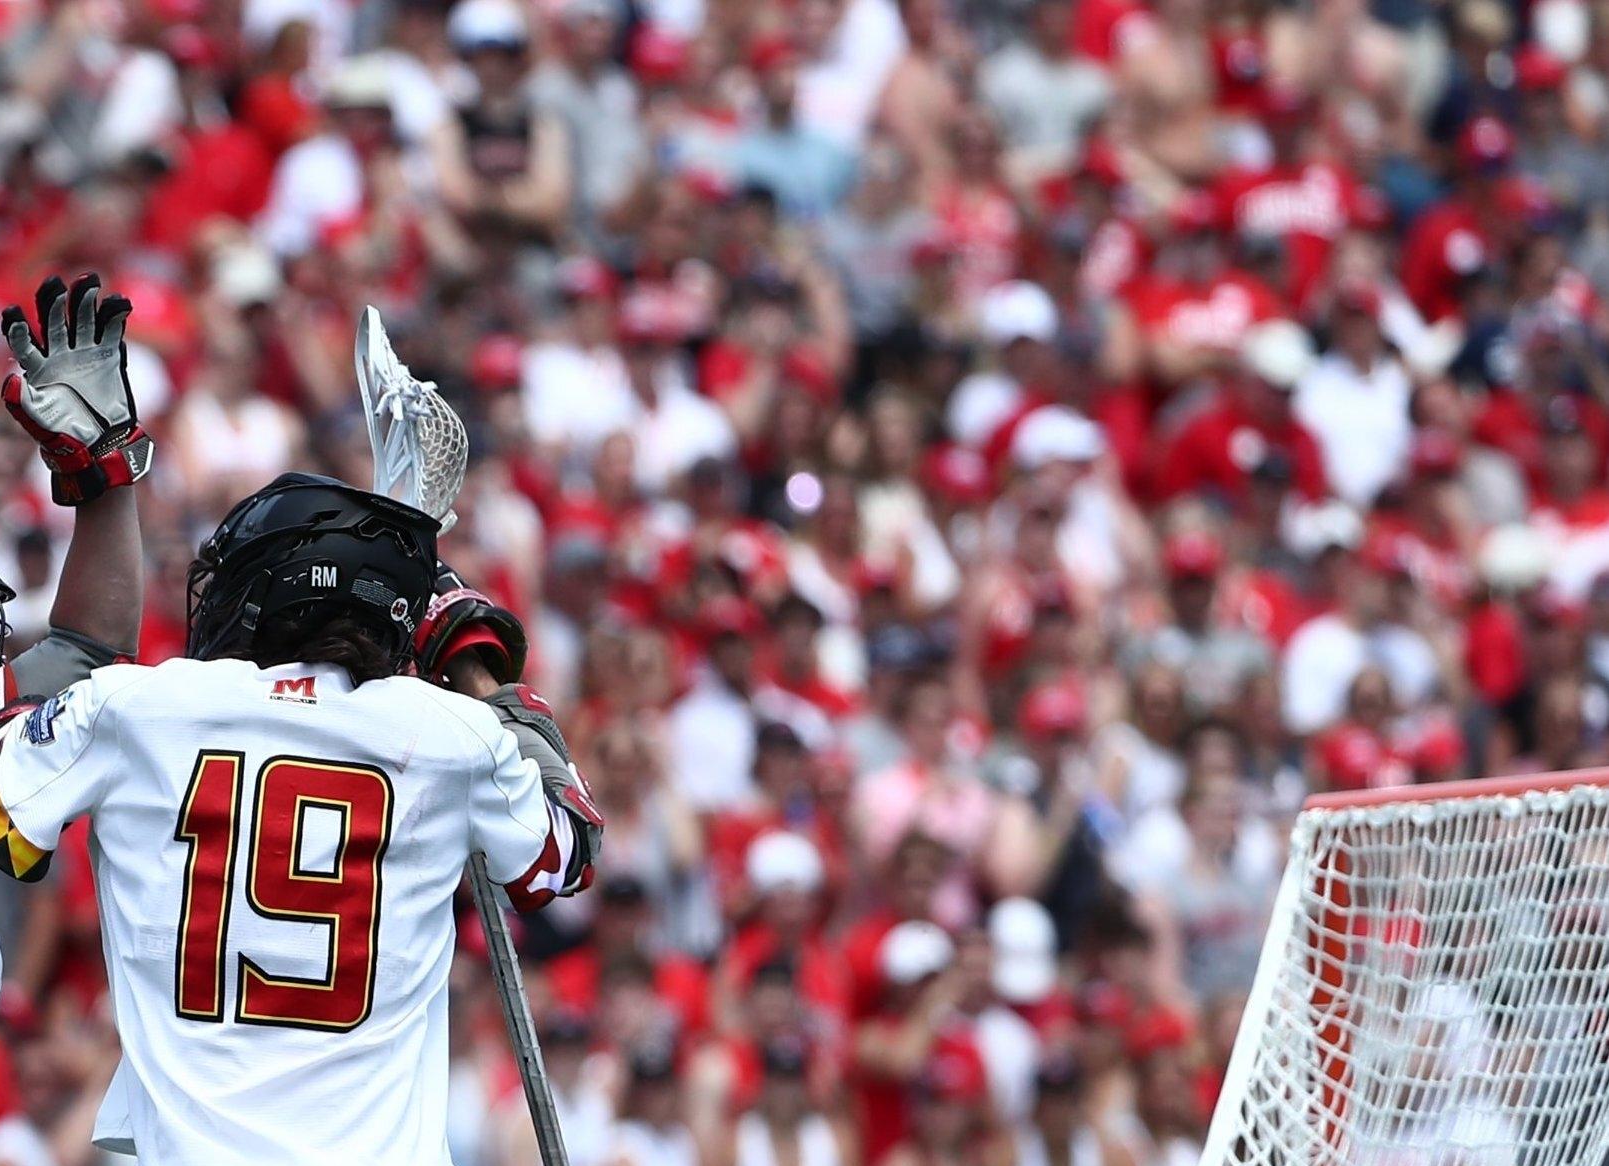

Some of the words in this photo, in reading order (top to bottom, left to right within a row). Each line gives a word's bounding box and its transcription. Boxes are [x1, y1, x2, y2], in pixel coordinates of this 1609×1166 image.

[311, 565, 338, 588] RM
[271, 676, 317, 698] M
[174, 749, 395, 1034] 19
